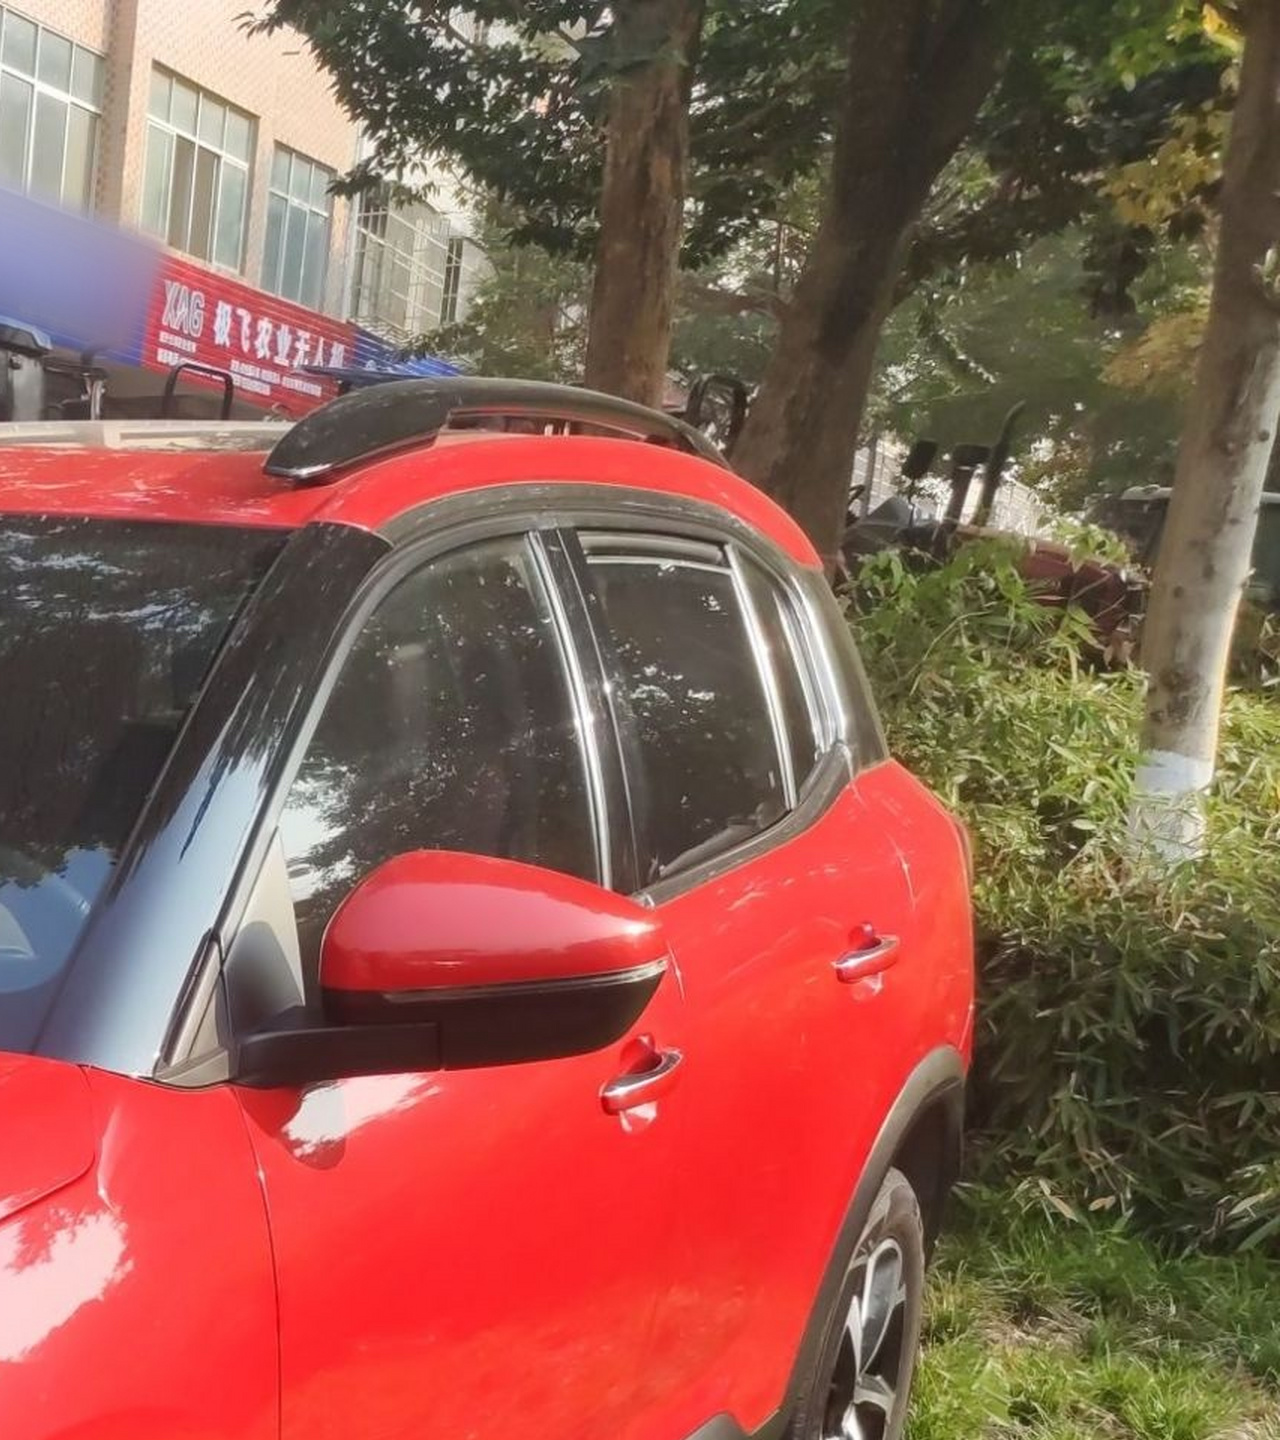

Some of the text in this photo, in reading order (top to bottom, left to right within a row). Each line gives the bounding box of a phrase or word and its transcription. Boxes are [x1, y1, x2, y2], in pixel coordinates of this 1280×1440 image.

[162, 280, 206, 338] XAG
[213, 300, 345, 369] 极飞农业无人机
